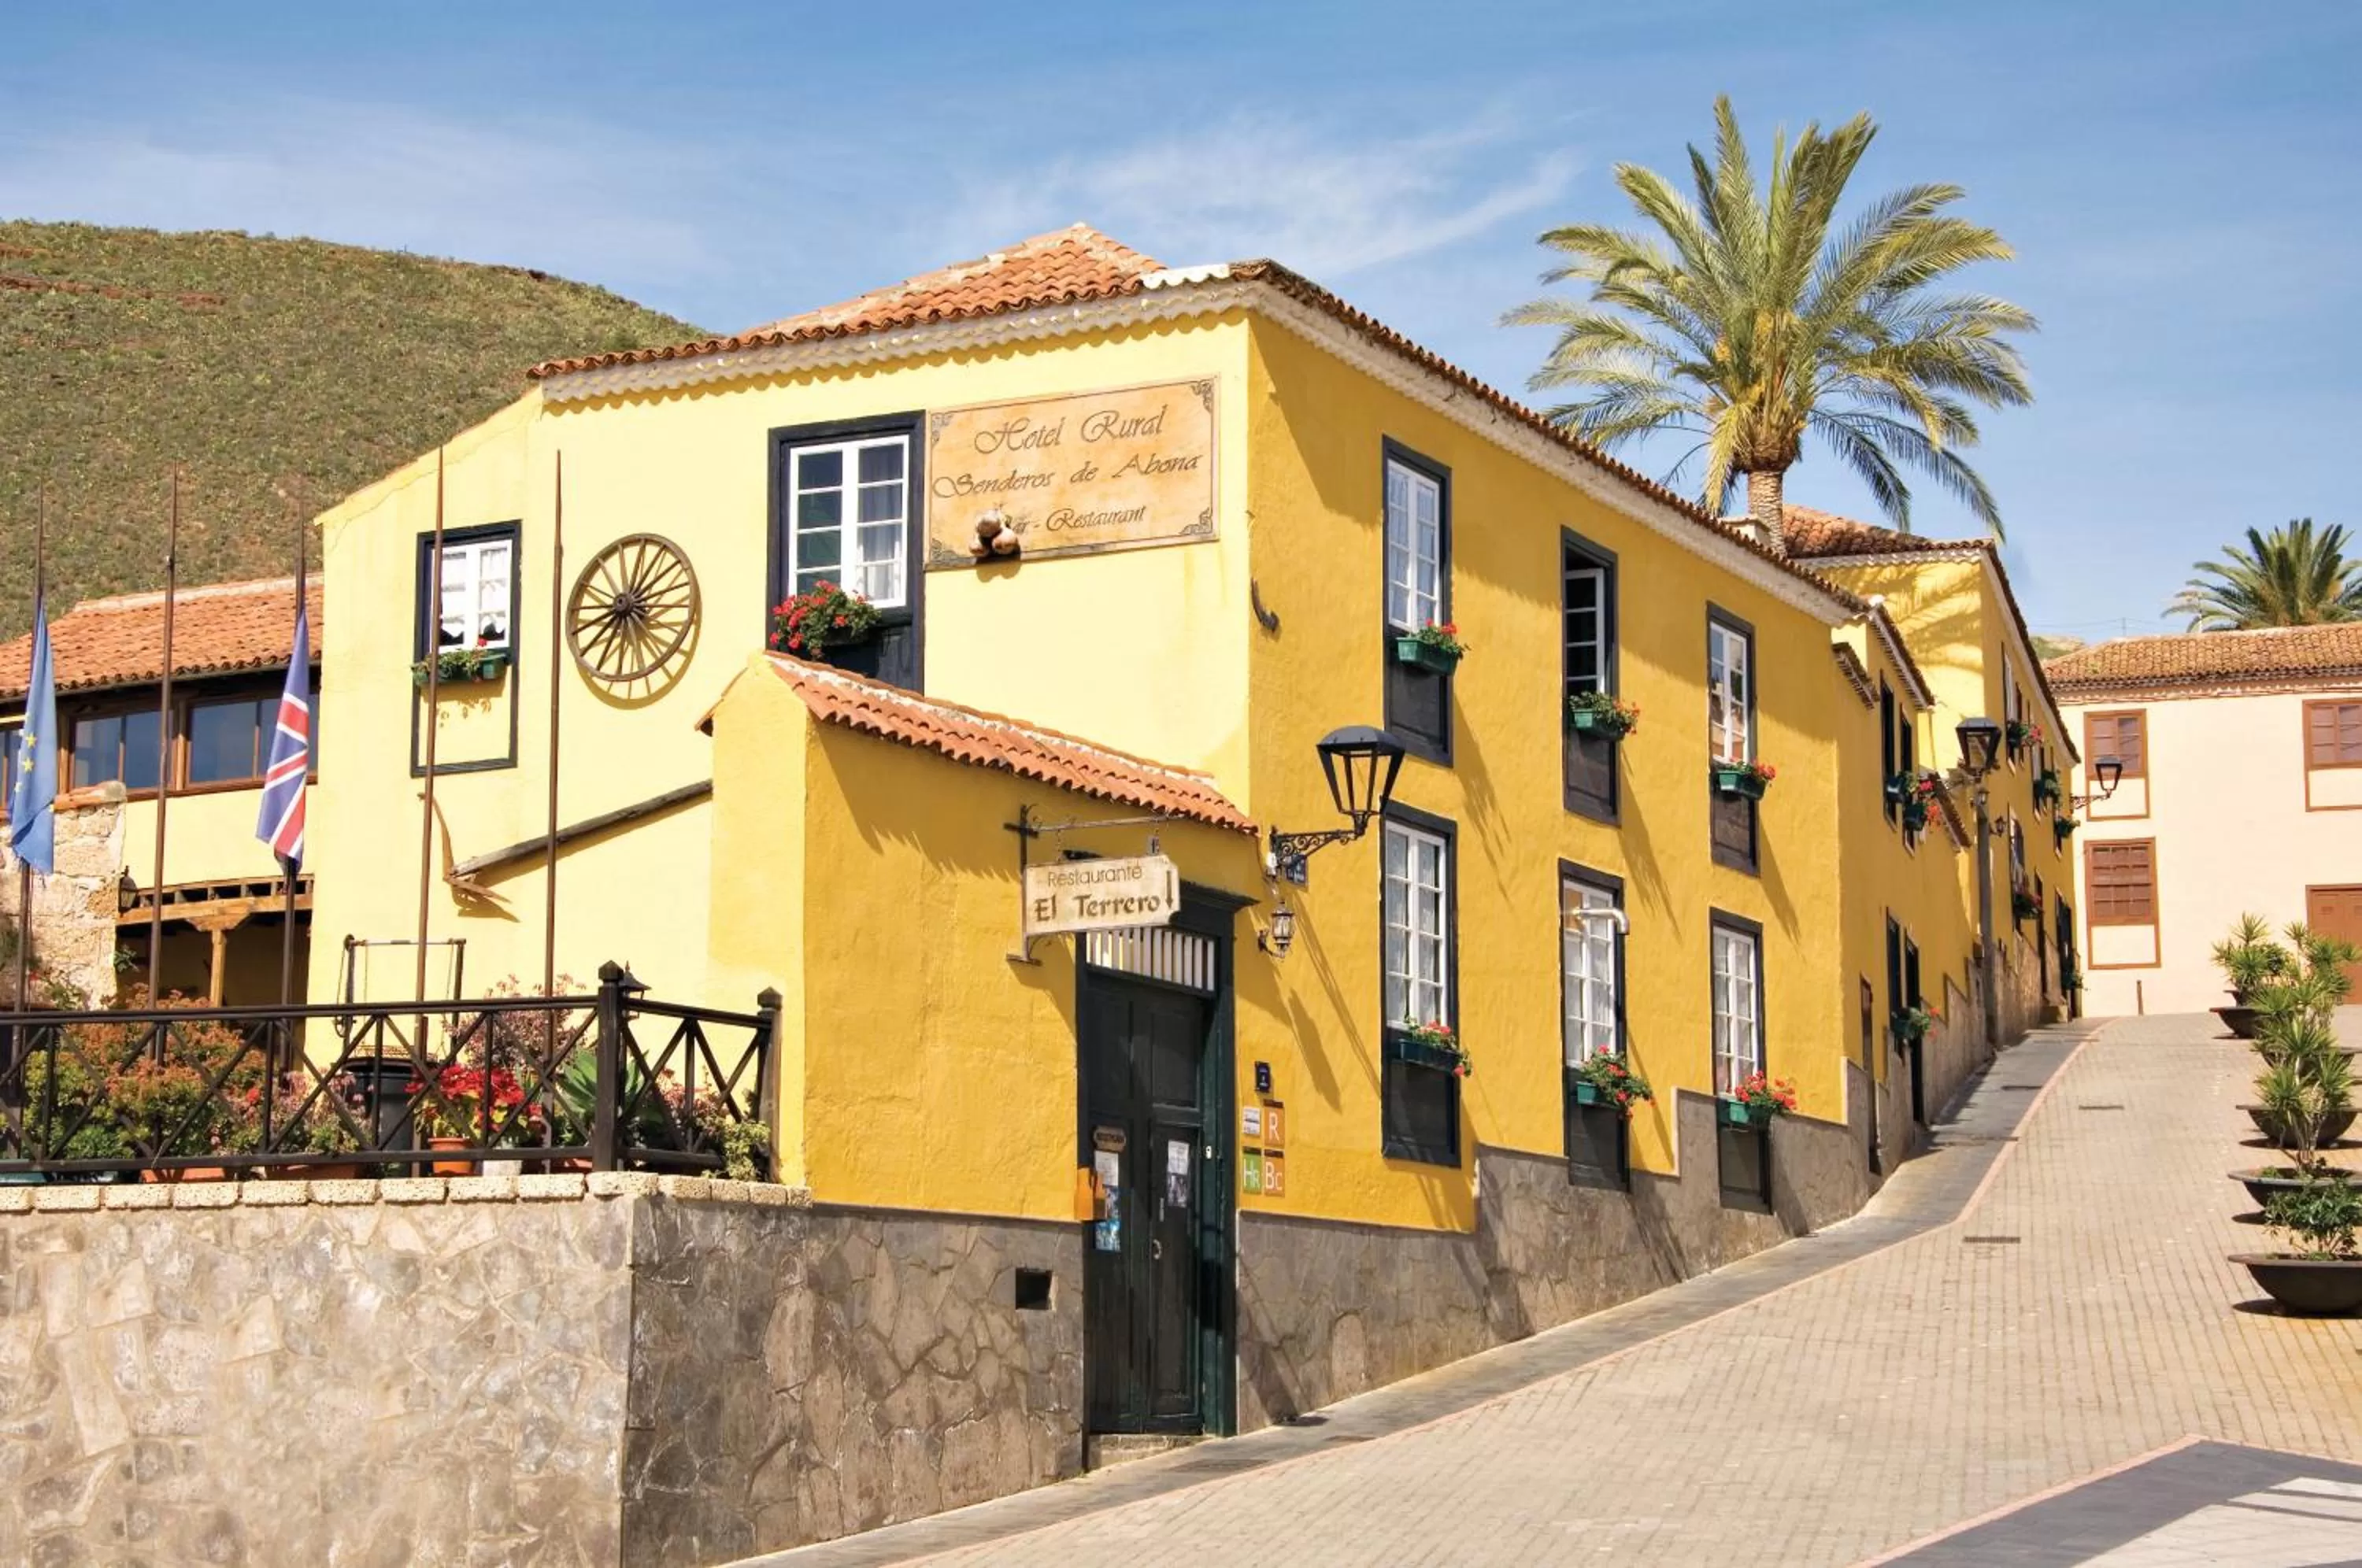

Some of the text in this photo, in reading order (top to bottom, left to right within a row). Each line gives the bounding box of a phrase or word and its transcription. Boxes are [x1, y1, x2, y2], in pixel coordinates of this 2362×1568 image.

[974, 403, 1168, 454] Hotel Rural
[932, 453, 1203, 498] Senderos de Abona
[1046, 505, 1146, 531] Restaurant
[1035, 893, 1161, 922] El Terrero
[1268, 1111, 1279, 1141] R
